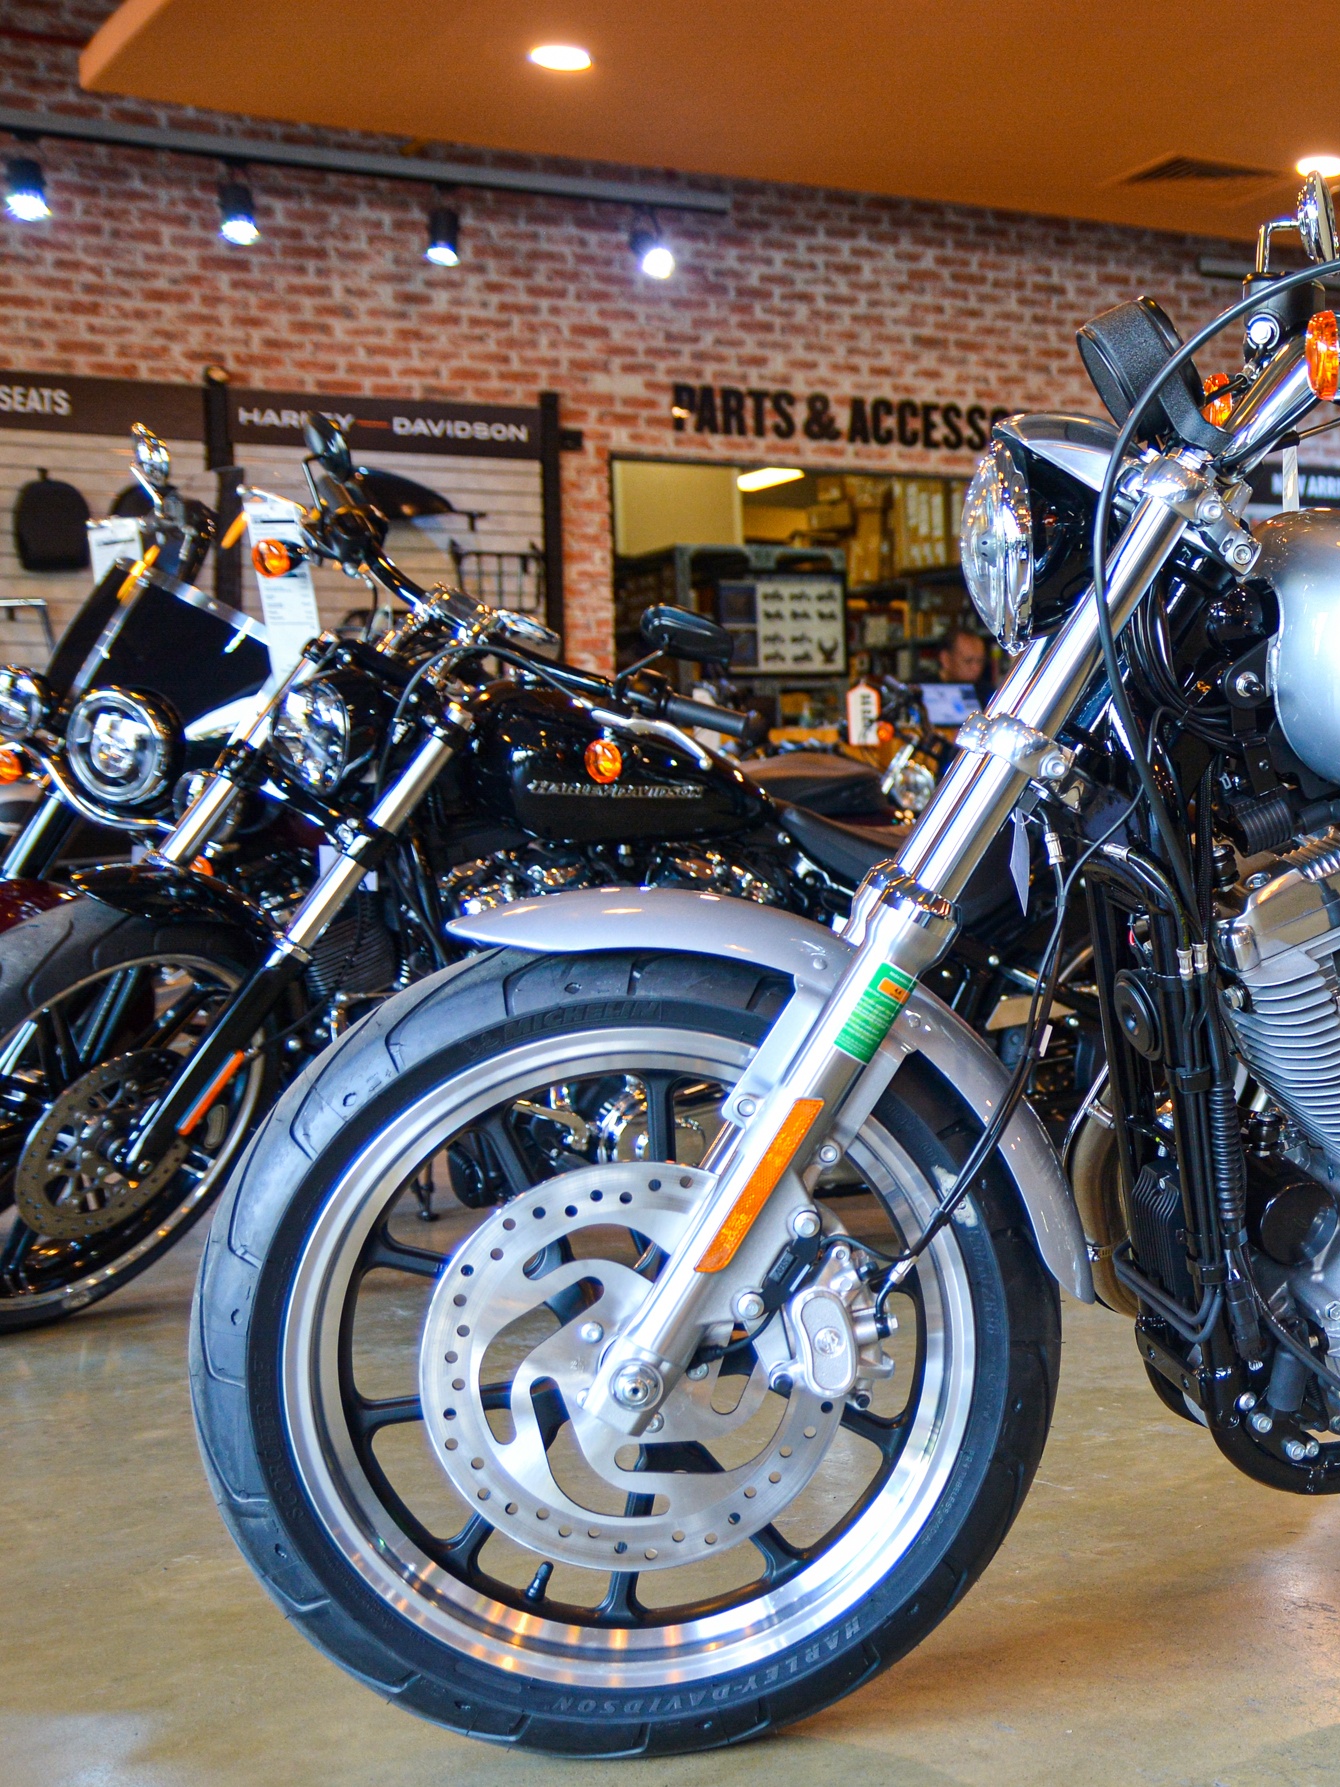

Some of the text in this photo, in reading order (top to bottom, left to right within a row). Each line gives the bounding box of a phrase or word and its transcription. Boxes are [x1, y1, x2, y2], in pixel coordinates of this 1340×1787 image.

[0, 384, 72, 416] SEATS
[672, 382, 796, 439] PARTS
[803, 392, 842, 441] &
[238, 405, 529, 443] HARY DAVIDSON
[1272, 472, 1306, 496] NW
[504, 1001, 660, 1038] MICHELIN
[255, 1401, 305, 1521] SCORCHER
[940, 1469, 967, 1514] TUBELESS
[551, 1616, 861, 1715] HARLEY-DAVIDSON
